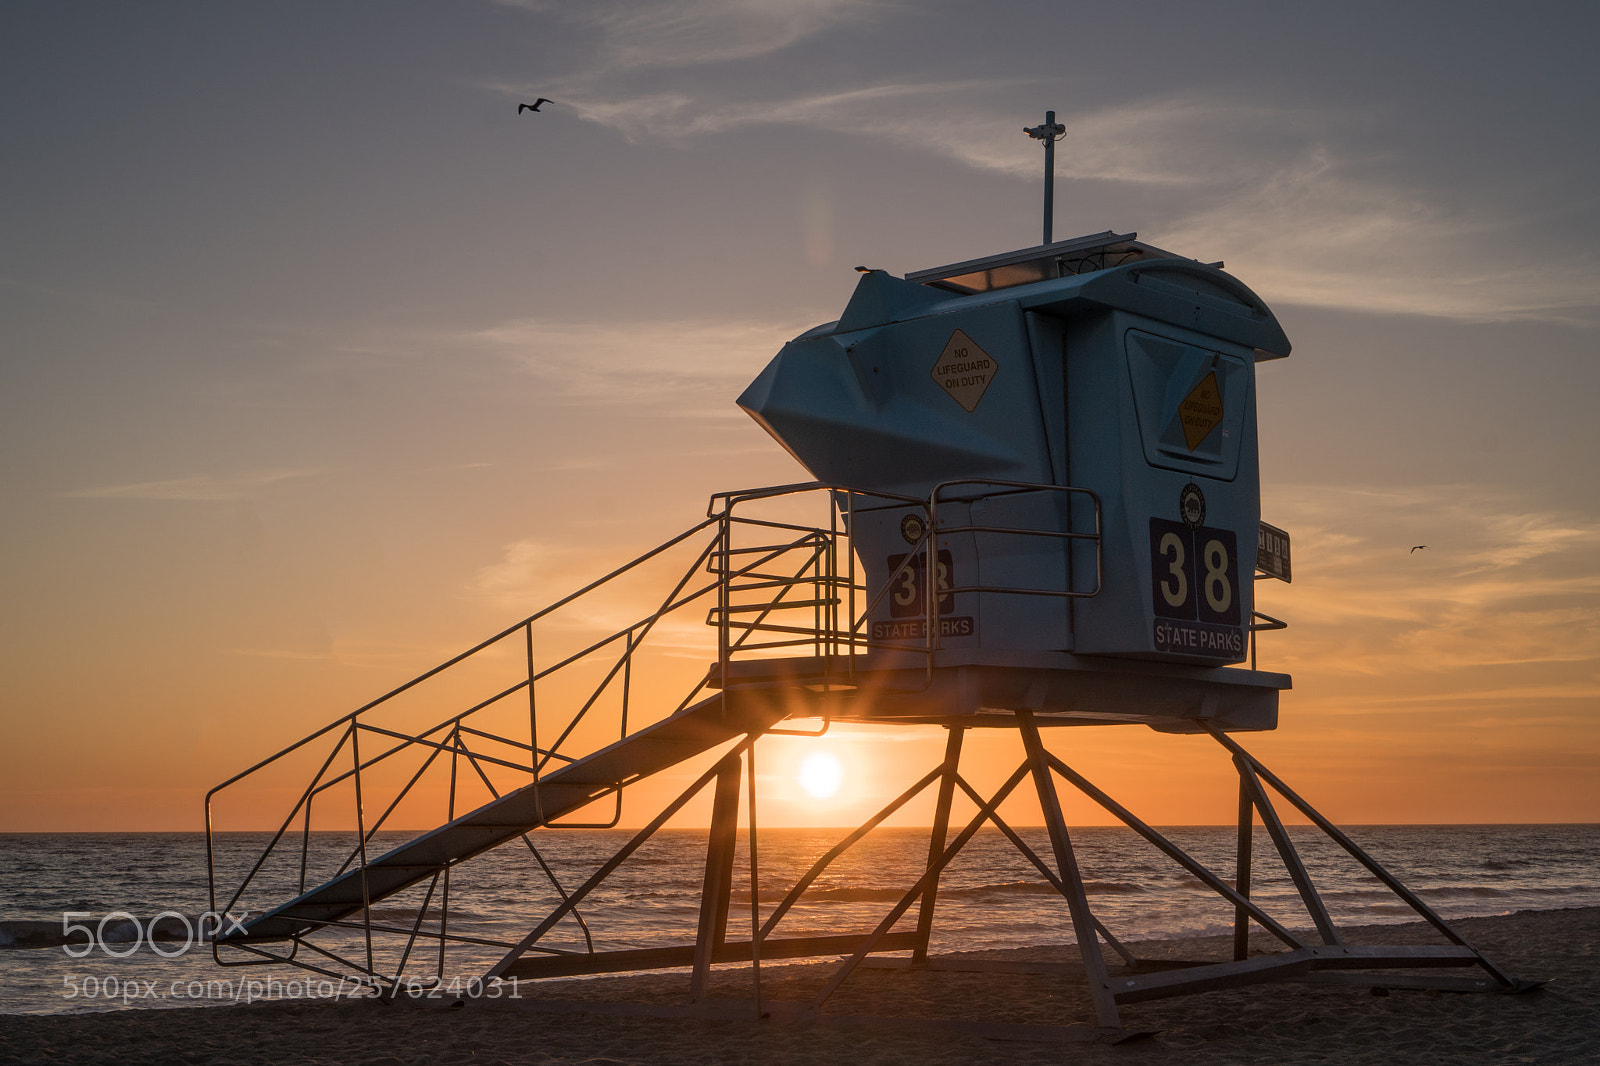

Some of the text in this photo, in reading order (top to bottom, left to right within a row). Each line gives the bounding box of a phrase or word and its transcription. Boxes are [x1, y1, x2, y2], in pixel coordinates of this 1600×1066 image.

[954, 348, 968, 358] NO
[937, 360, 990, 375] LIFEGUARD
[945, 375, 986, 389] ON DUTY
[1159, 532, 1232, 613] 38
[874, 620, 970, 638] STATE PRKS
[1156, 625, 1242, 652] STATE PARKS
